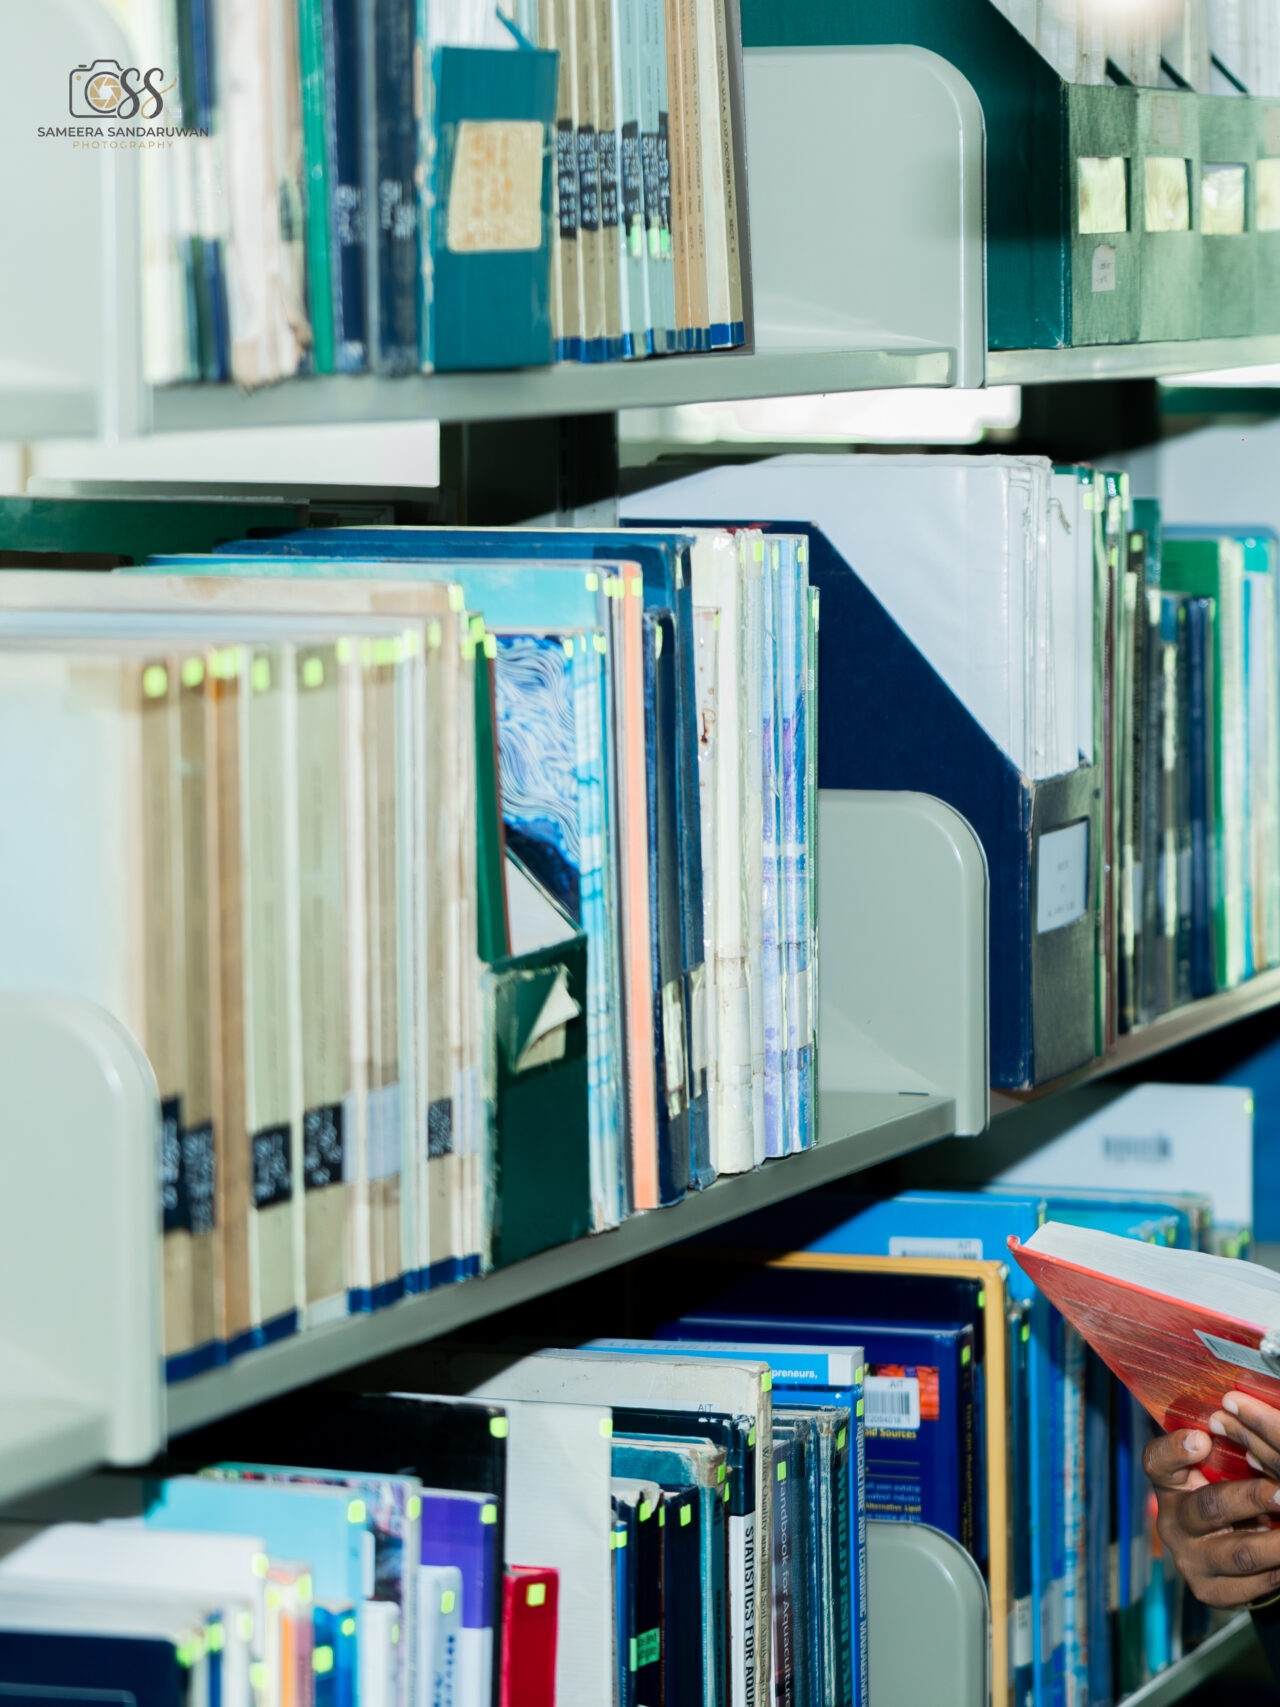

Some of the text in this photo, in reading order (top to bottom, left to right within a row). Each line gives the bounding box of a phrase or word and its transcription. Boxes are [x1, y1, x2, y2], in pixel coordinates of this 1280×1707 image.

[855, 1421, 865, 1513] AQUACULTURE
[761, 1485, 769, 1531] Quality
[837, 1464, 848, 1571] WORLD
[858, 1516, 867, 1544] AND
[744, 1526, 755, 1621] STATISTICS
[781, 1570, 790, 1596] for
[858, 1547, 867, 1618] ECONOMIC
[744, 1624, 755, 1661] FOR
[839, 1575, 850, 1643] FISH
